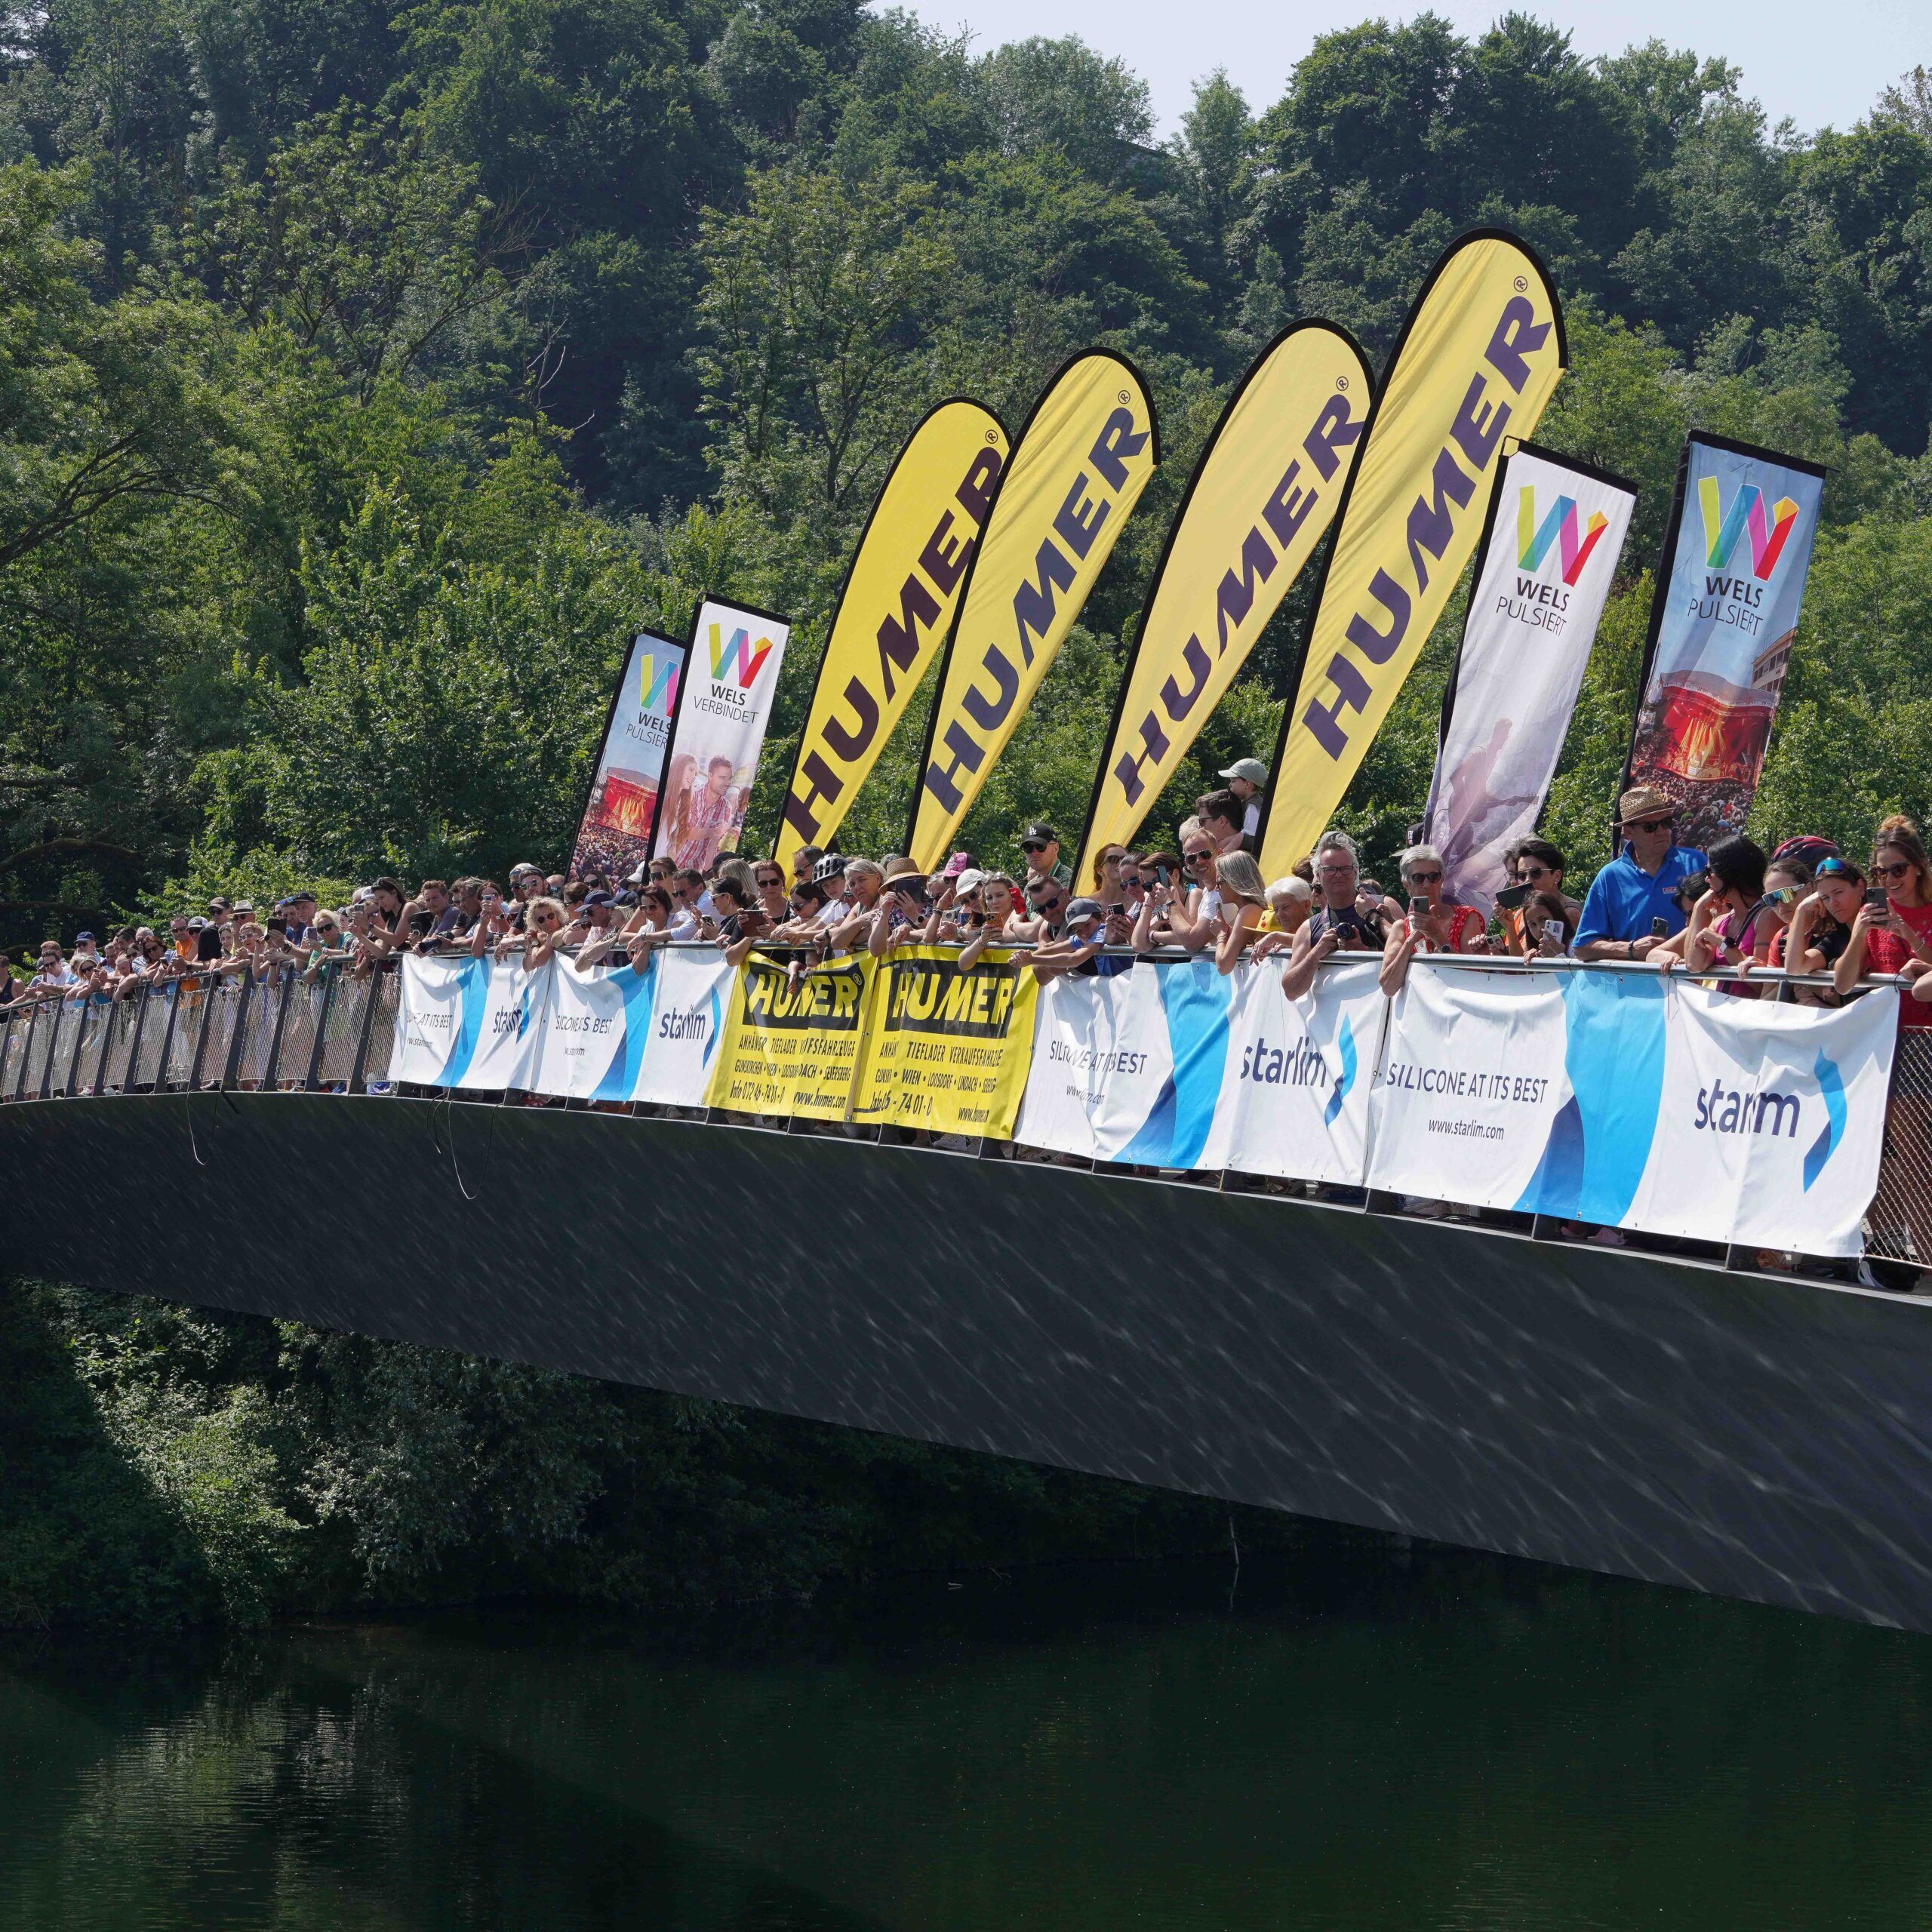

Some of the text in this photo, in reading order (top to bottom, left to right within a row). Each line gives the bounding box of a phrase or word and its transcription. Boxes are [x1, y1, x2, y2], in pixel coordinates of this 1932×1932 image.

[1303, 296, 1552, 761] HUMER
[1113, 394, 1364, 808] HUMER
[1517, 577, 1570, 612] WELS
[1706, 576, 1763, 608] WELS
[924, 408, 1150, 816] HUMER
[1496, 595, 1567, 637] PULSIERT
[1687, 598, 1763, 635] PULSIERT
[784, 447, 1002, 844] HUMER
[694, 695, 759, 724] VERBINDET
[712, 684, 746, 706] WELS
[626, 723, 667, 749] PULSIER
[638, 711, 671, 735] WELS
[1028, 826, 1037, 836] LA
[891, 973, 1015, 1024] HUMER
[592, 1018, 612, 1034] BEST
[770, 1038, 797, 1055] TIEFLADER
[906, 1041, 946, 1063] TIEFLADER
[1240, 1036, 1327, 1088] starlim
[730, 1080, 743, 1099] Info
[902, 1069, 921, 1085] WIEN
[928, 1072, 953, 1089] LOOSDORF
[958, 1075, 978, 1092] LINDACH
[1386, 1063, 1549, 1103] SILICONE AT ITS BEST
[1429, 1119, 1504, 1140] www.starlim.com
